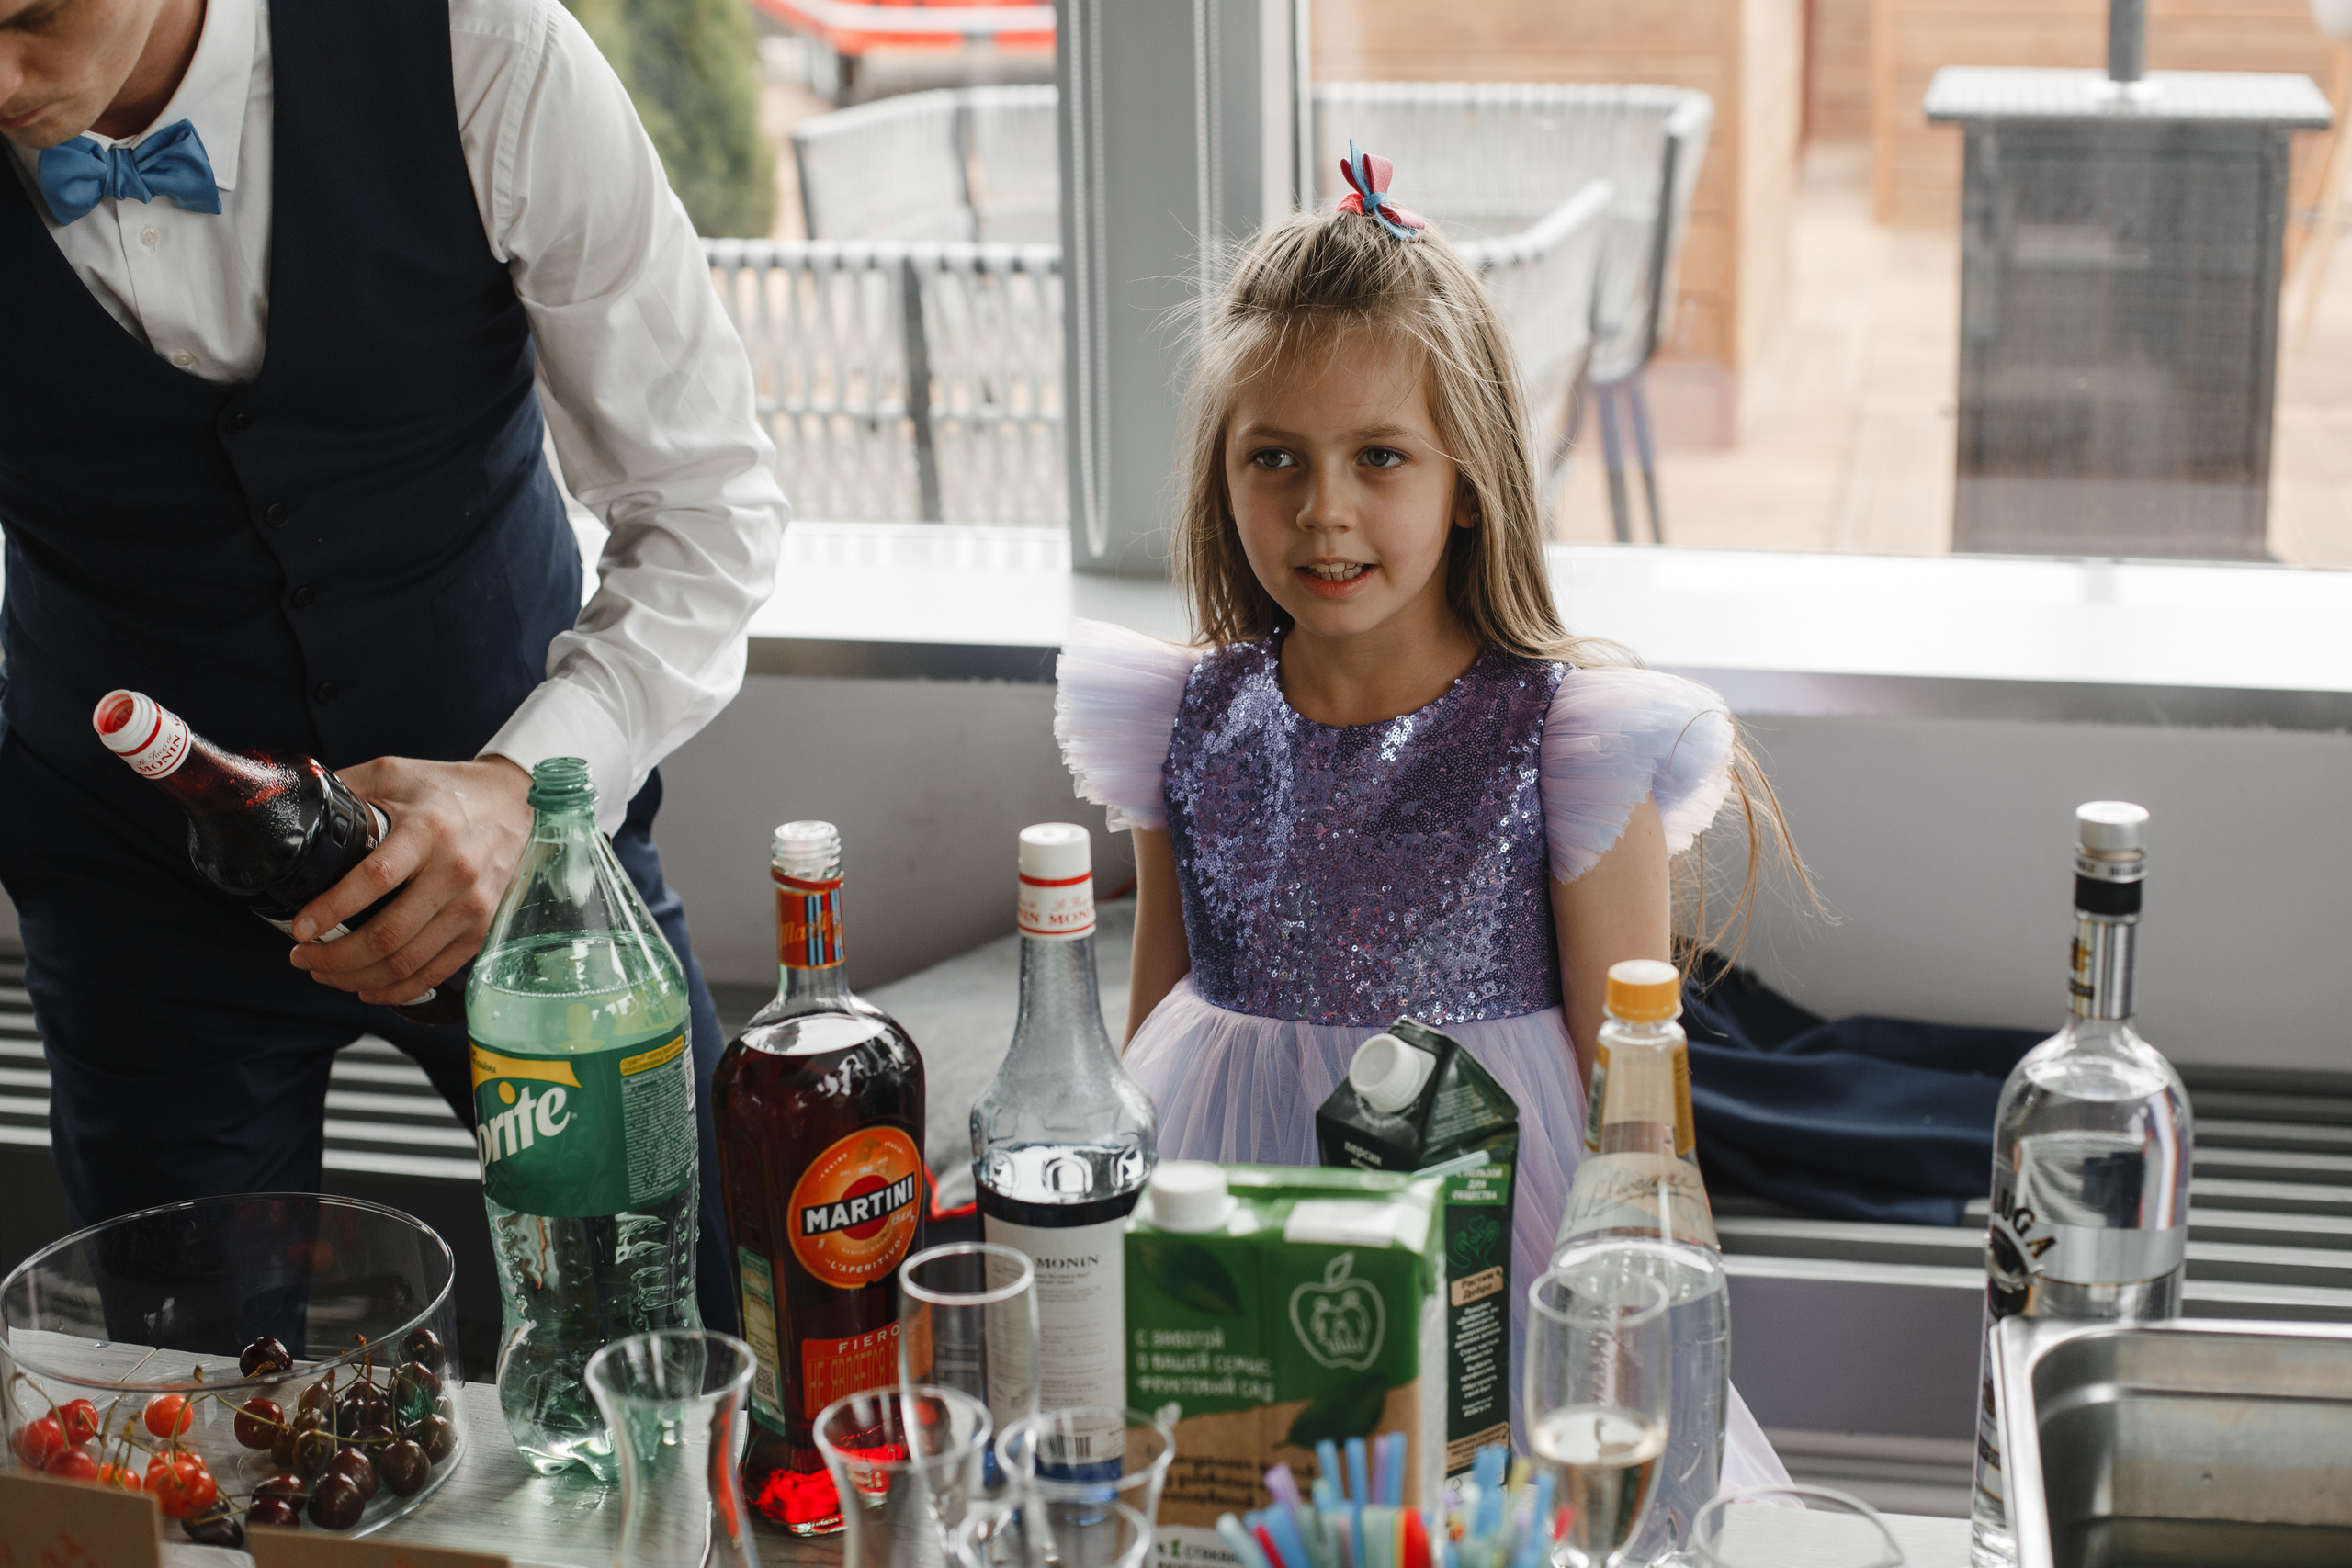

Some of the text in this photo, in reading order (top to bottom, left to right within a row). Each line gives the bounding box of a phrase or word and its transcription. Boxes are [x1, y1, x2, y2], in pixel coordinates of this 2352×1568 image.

[138, 734, 181, 773] MONIN
[476, 1080, 571, 1186] prite
[806, 1175, 913, 1234] MARTINI
[2001, 1188, 2057, 1261] UGA
[1036, 1255, 1099, 1269] MONIN
[838, 1324, 900, 1354] FIERO
